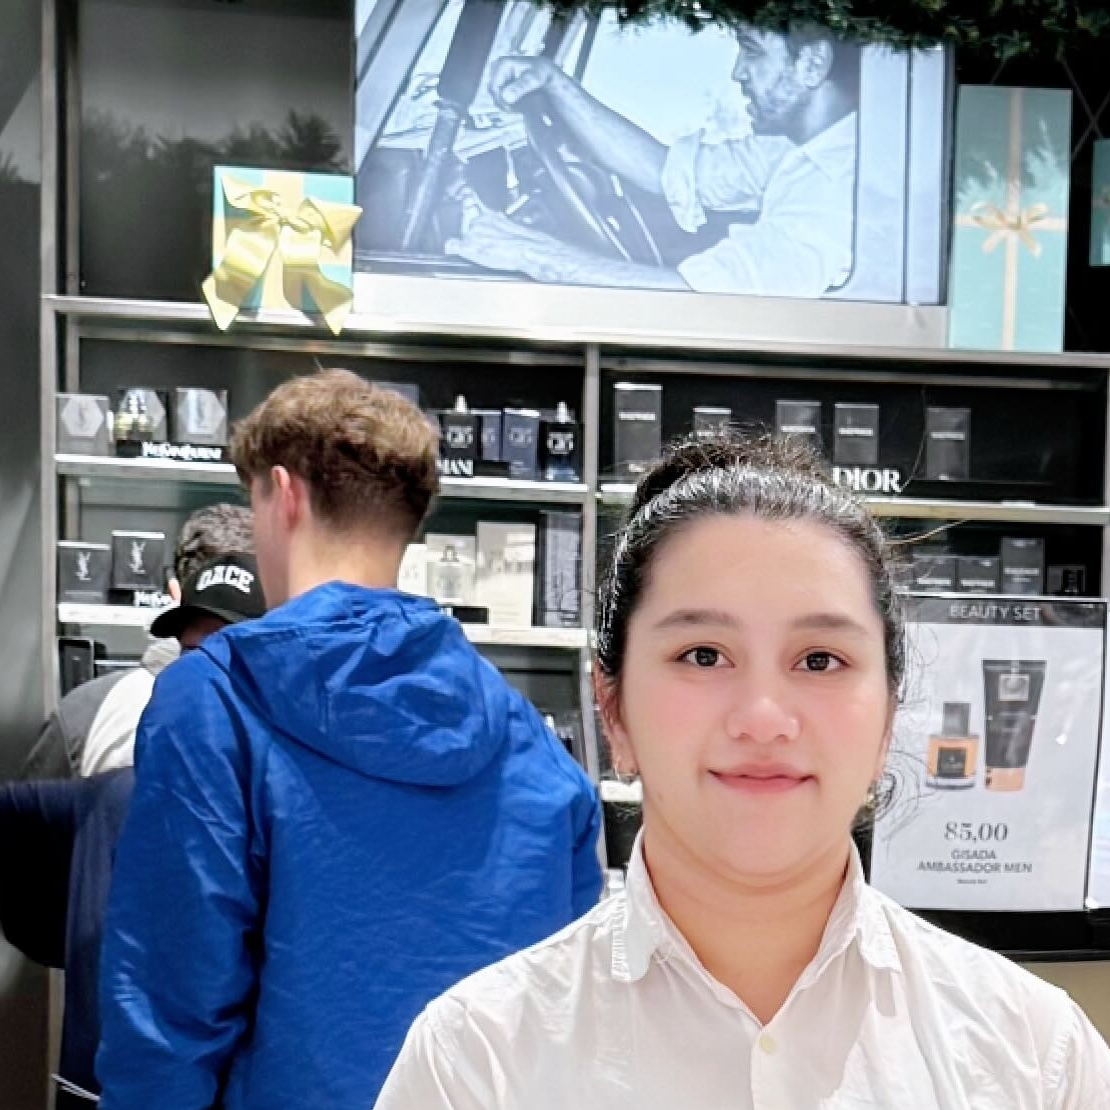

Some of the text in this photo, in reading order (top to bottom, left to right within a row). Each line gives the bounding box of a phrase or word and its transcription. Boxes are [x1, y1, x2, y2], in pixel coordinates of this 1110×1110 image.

[833, 467, 902, 492] DIOR
[951, 605, 1042, 621] BEAUTY SET
[944, 821, 1009, 843] 85,00
[951, 849, 997, 860] GISADA
[917, 861, 1033, 873] AMBASSADOR MEN
